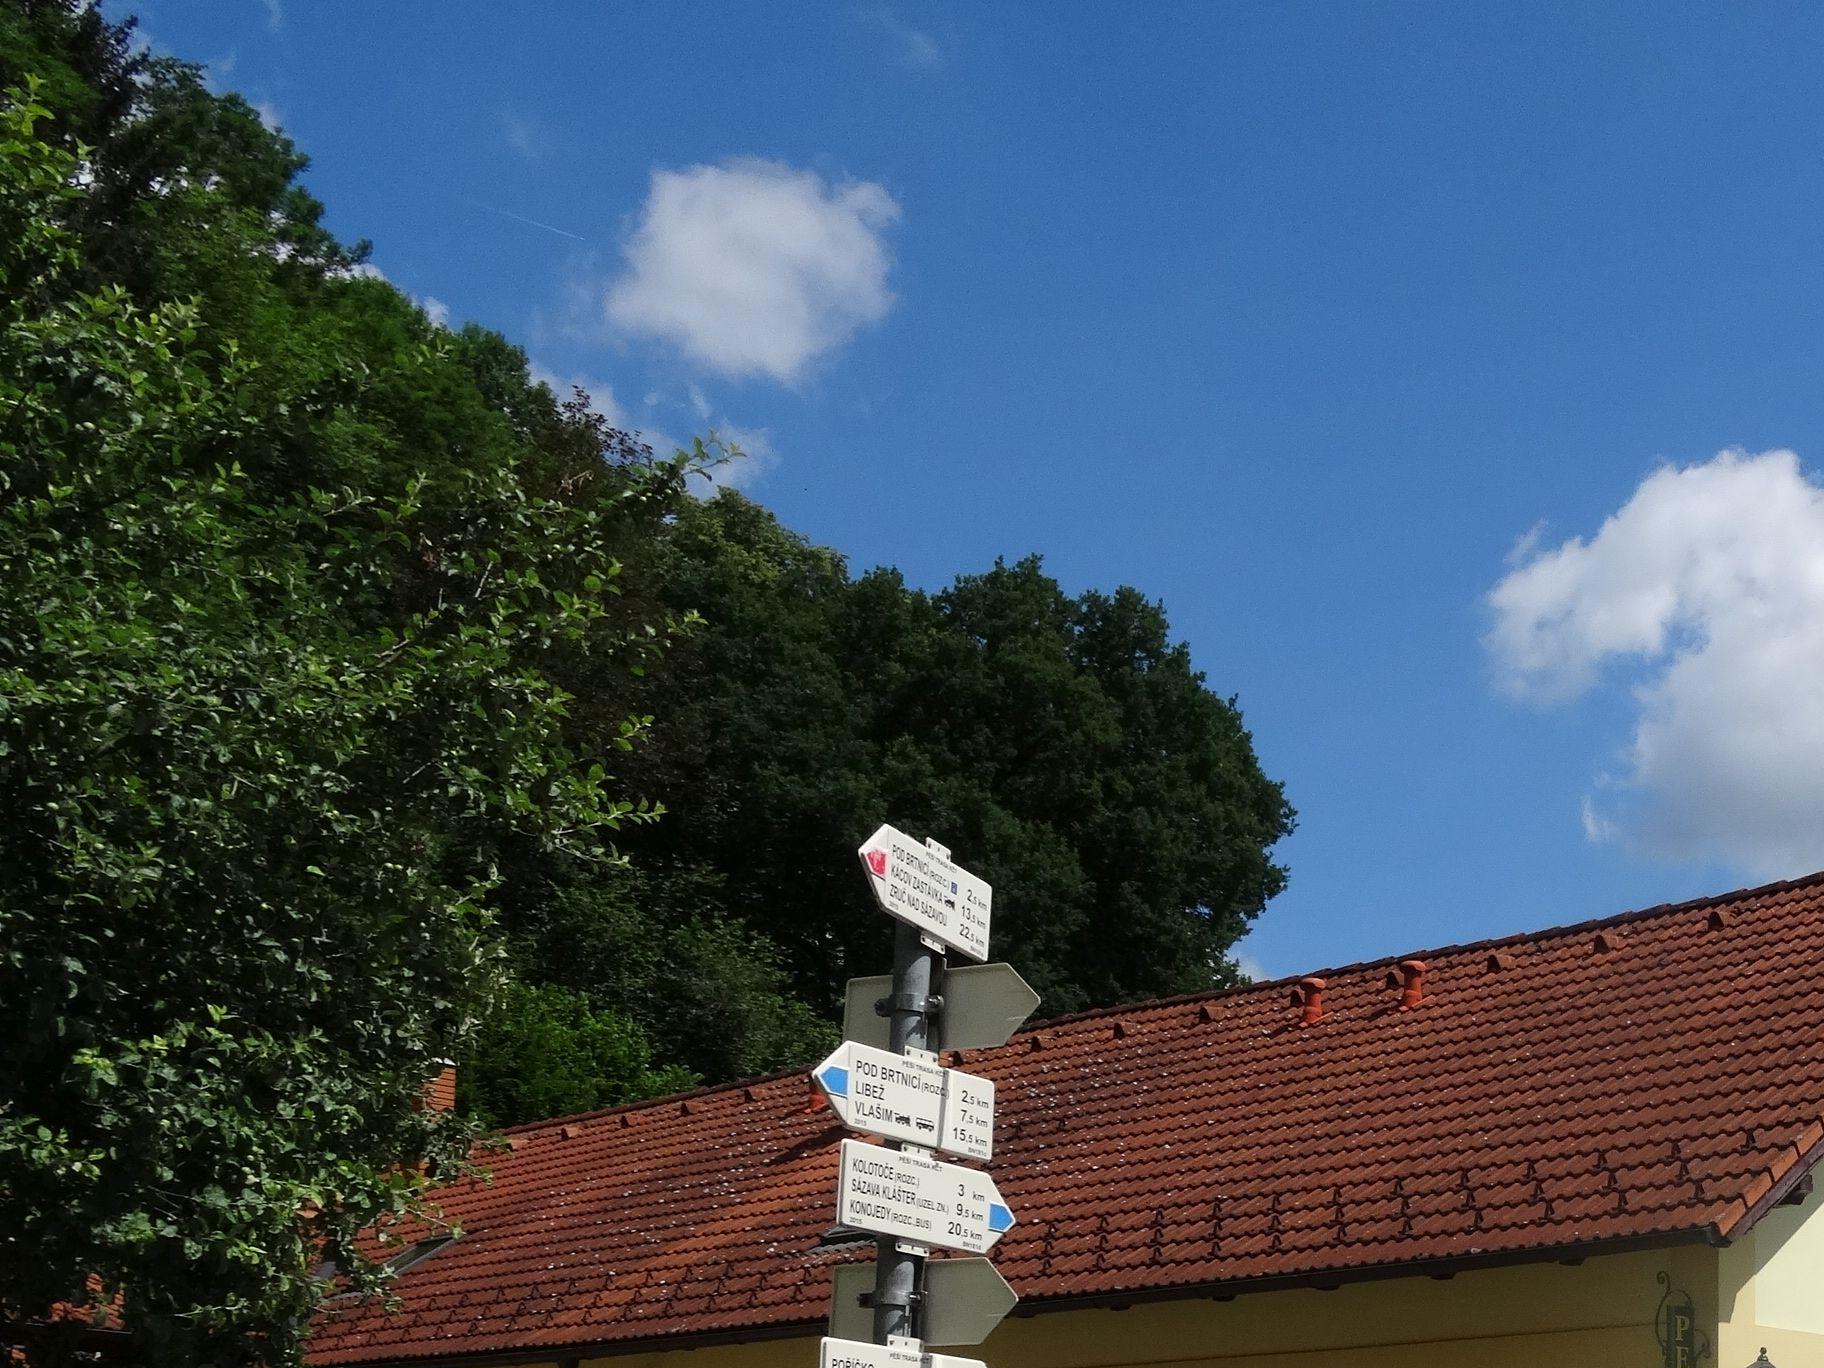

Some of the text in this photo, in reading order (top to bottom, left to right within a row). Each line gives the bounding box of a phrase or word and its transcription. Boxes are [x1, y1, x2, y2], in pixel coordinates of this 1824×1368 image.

[892, 844, 905, 862] POD
[906, 852, 930, 875] BRTNICÍ
[892, 864, 943, 904] KÁCOV ZASTÁVKA
[890, 883, 906, 904] ZRUČ
[908, 893, 920, 911] NAD
[921, 900, 947, 926] SÁZAVOU
[978, 899, 987, 911] km
[977, 916, 986, 929] km
[975, 935, 985, 947] km
[856, 1060, 878, 1078] POD
[881, 1066, 921, 1090] BRTNICÍ
[855, 1080, 885, 1101] LIBEŽ
[855, 1100, 893, 1123] VLAŠIM
[977, 1097, 989, 1109] km
[976, 1117, 988, 1128] km
[975, 1136, 987, 1147] km
[852, 1158, 893, 1180] KOLOTOČE
[851, 1176, 880, 1198] SÁZAVA
[882, 1184, 916, 1206] KLÁŠTER
[958, 1184, 985, 1202] 3 km
[850, 1199, 891, 1220] KONOJEDY
[971, 1210, 983, 1221] km
[970, 1230, 982, 1241] km
